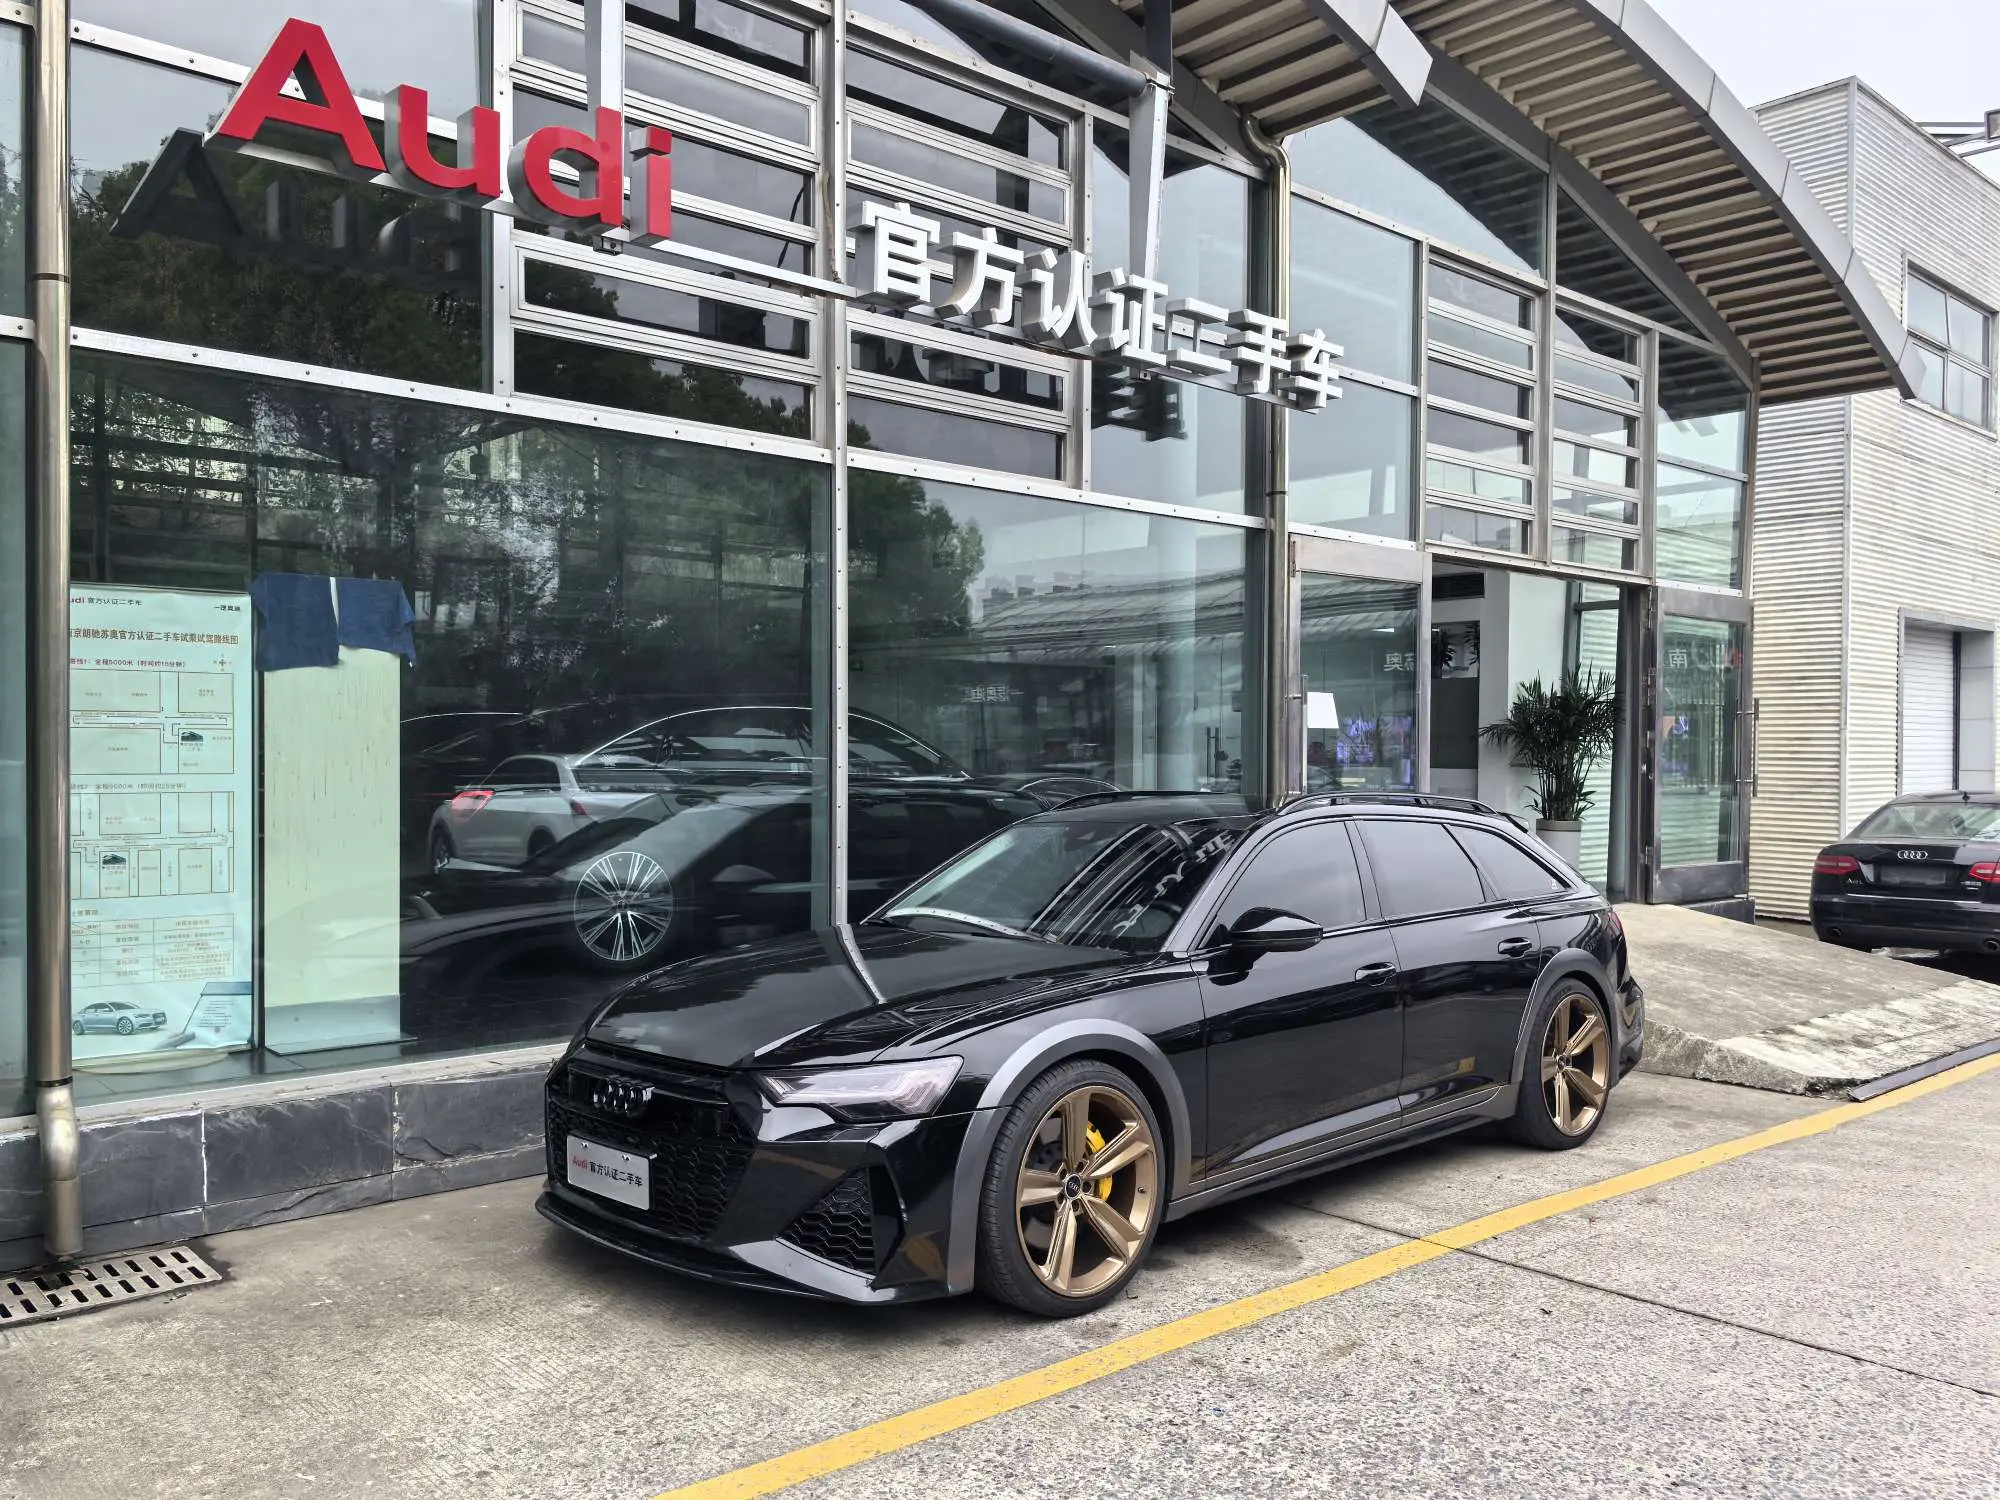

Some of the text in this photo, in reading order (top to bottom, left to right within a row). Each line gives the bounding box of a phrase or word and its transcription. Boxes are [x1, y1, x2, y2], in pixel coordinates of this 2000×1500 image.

[206, 18, 672, 242] Audi
[851, 202, 1345, 412] 官方认证二手车
[572, 1154, 643, 1188] Audi 官方认证二手车
